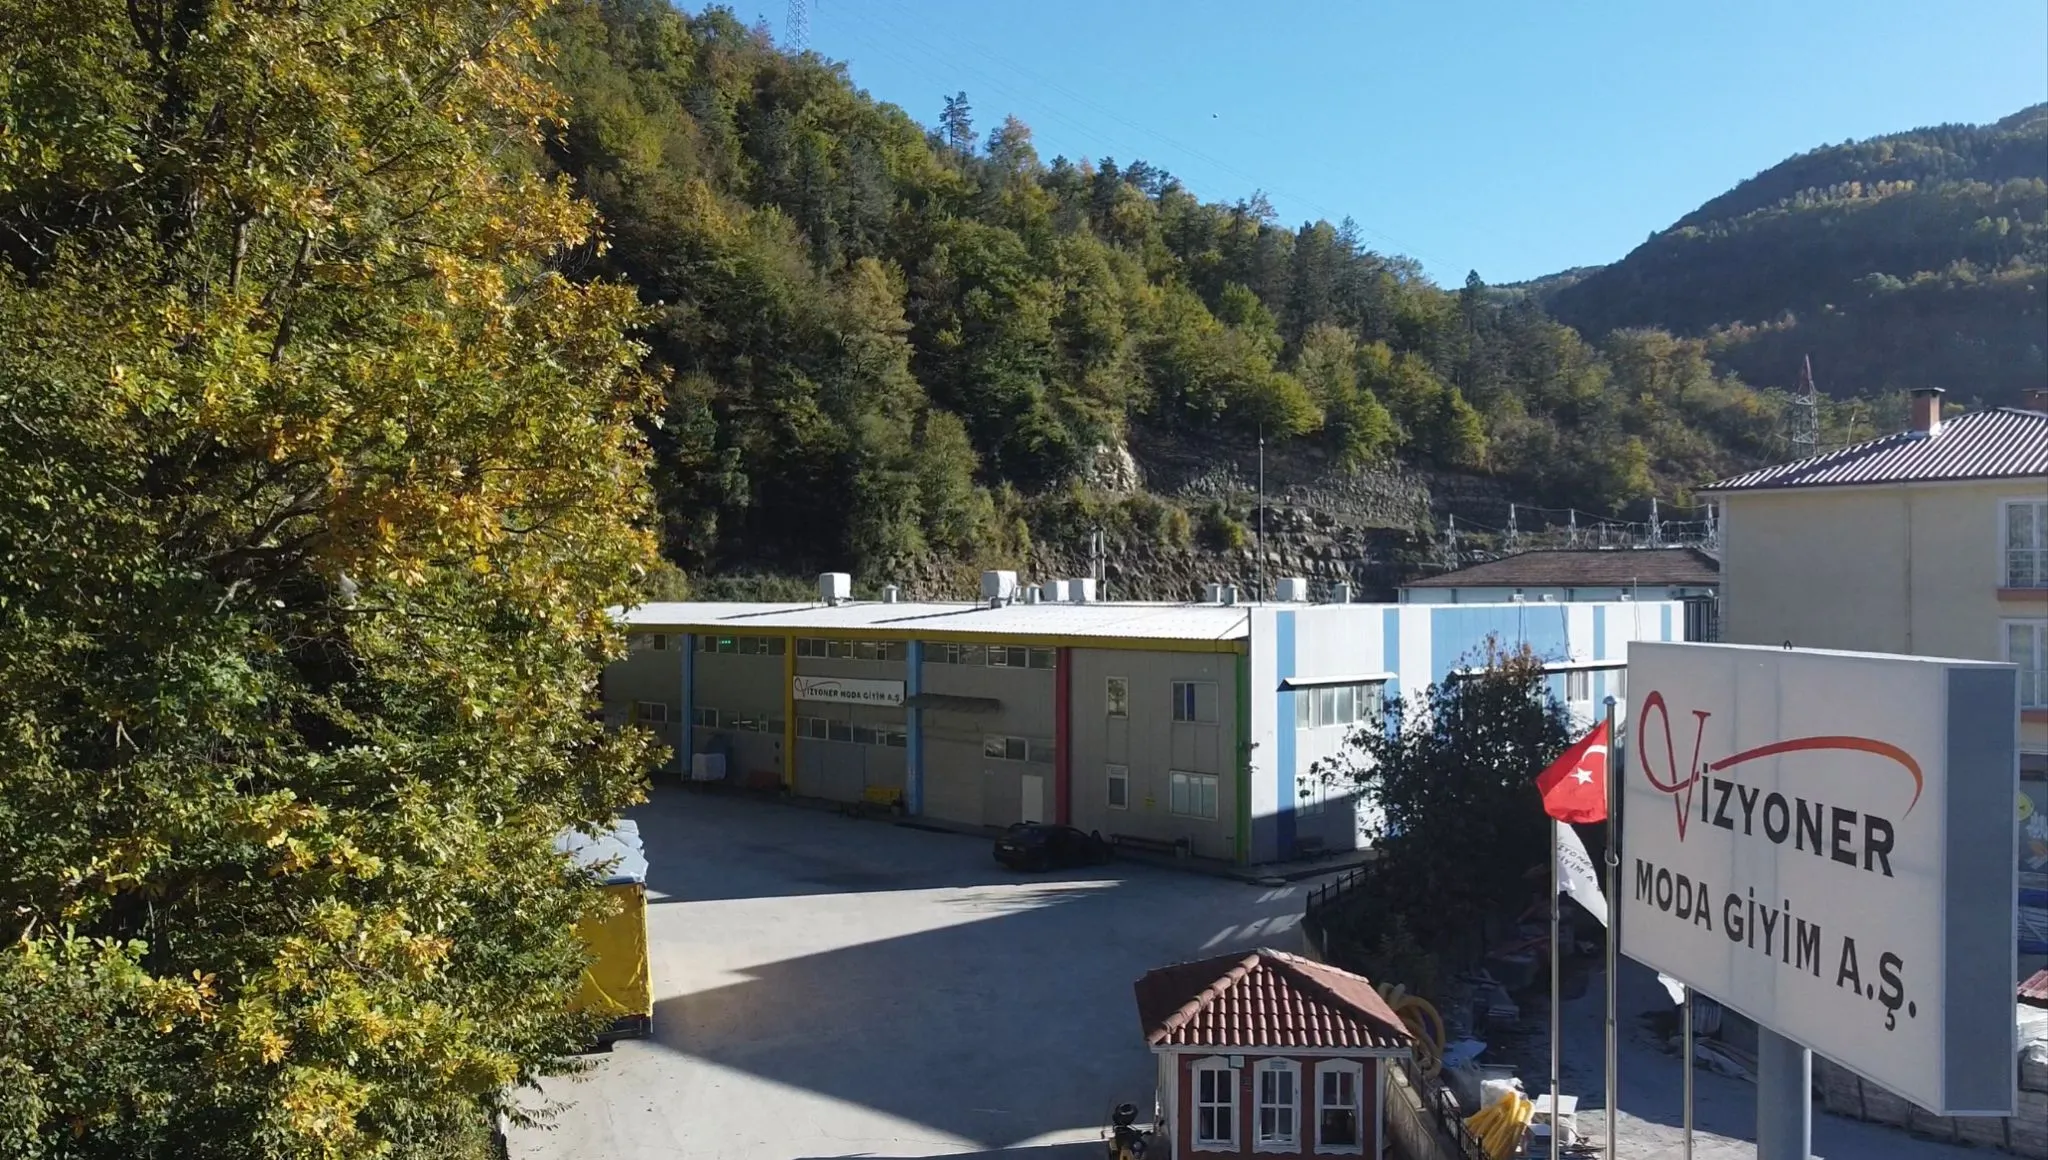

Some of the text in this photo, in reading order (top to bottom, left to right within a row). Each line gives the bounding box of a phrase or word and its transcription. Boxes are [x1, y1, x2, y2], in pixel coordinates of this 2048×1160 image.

[794, 677, 839, 698] VİZYONER
[840, 690, 861, 700] MODA
[863, 689, 885, 701] GİYİM
[1639, 690, 1895, 877] VİZYONER
[1635, 858, 1917, 1031] MODA GİYİM A.Ş.
